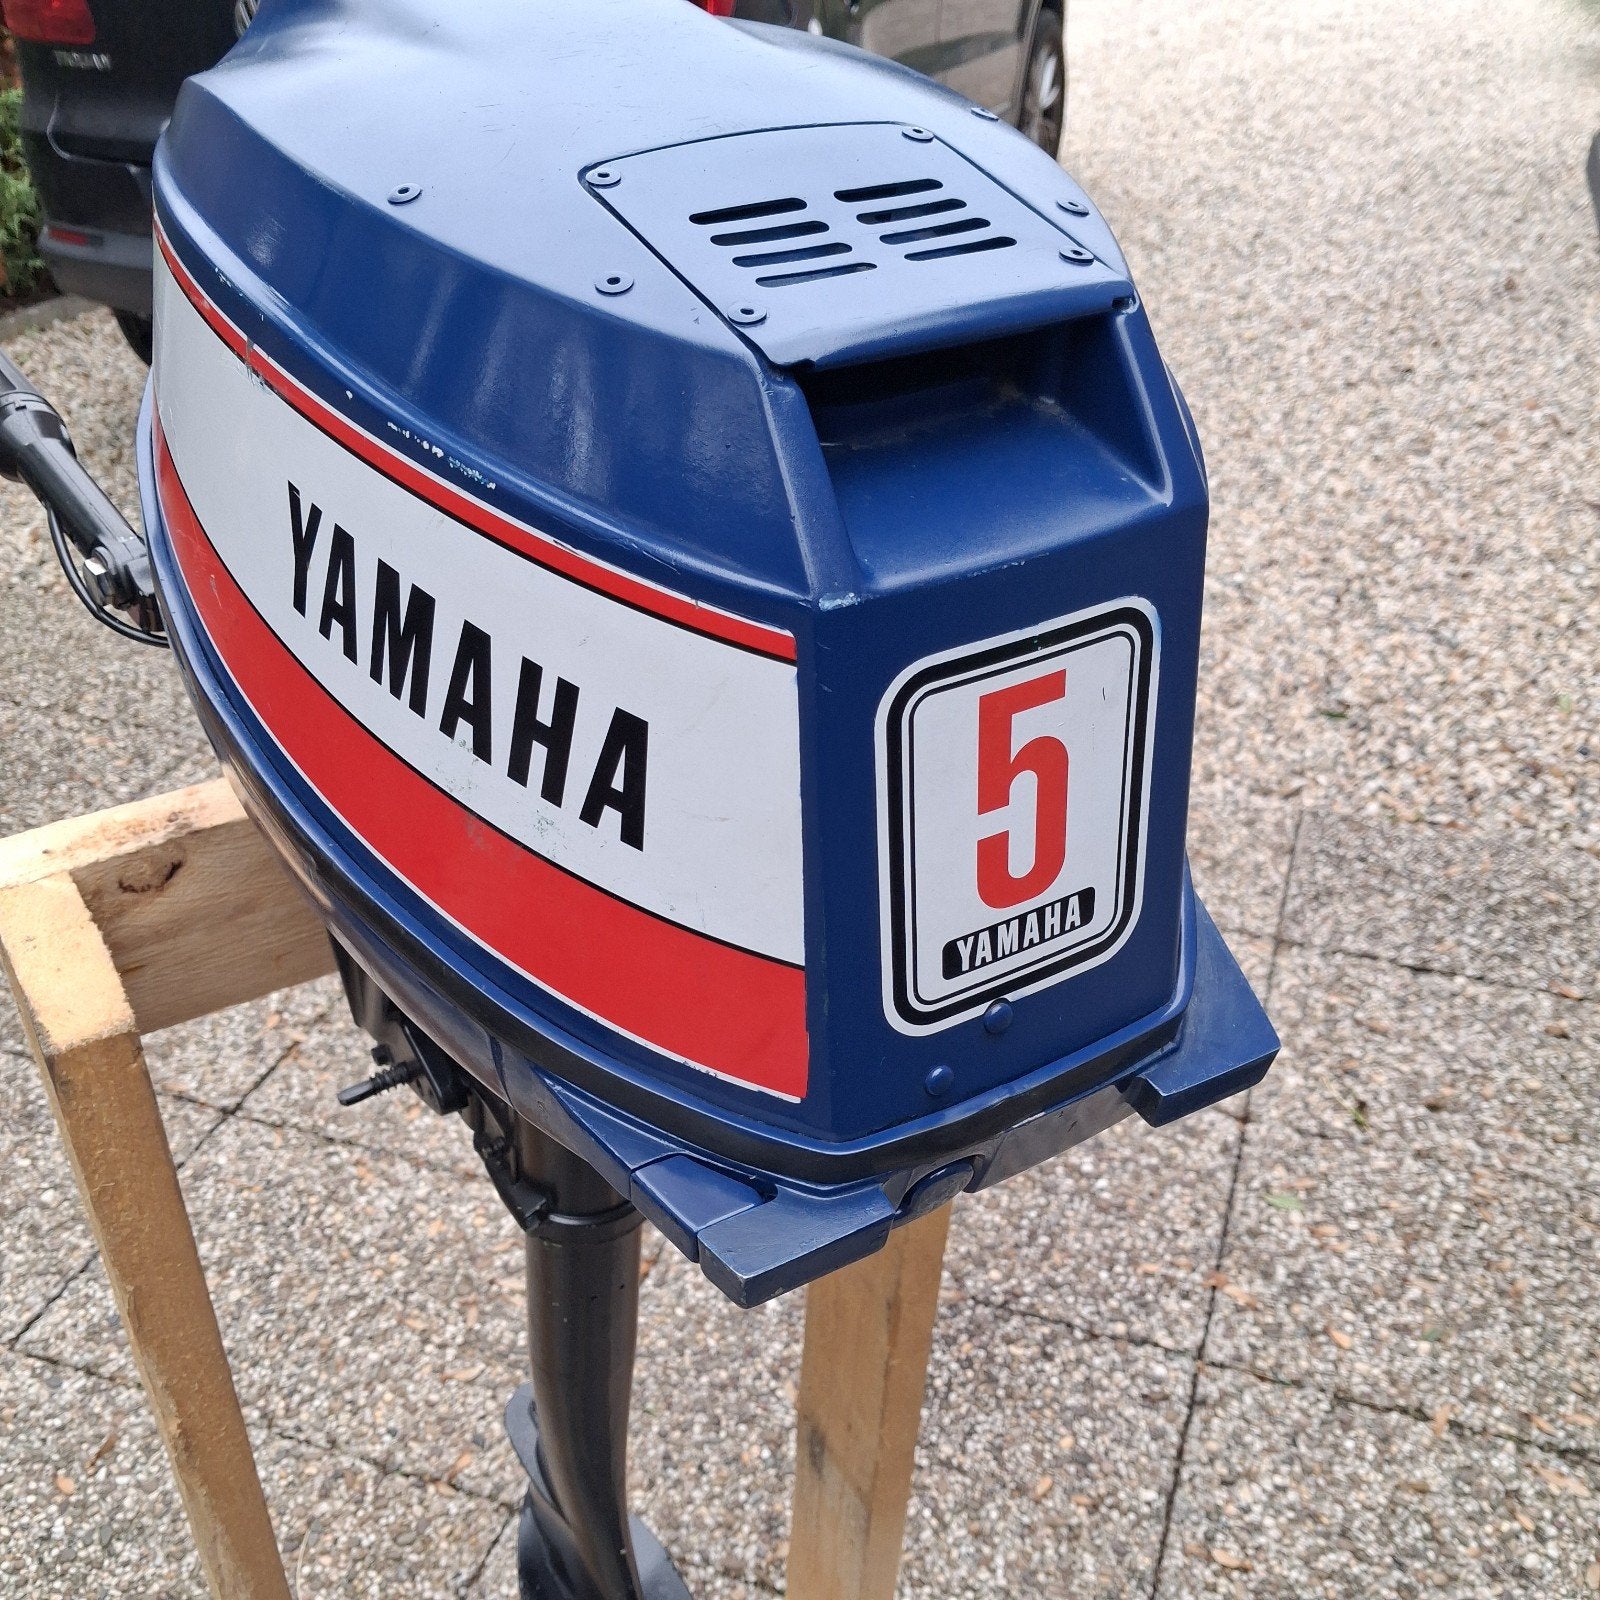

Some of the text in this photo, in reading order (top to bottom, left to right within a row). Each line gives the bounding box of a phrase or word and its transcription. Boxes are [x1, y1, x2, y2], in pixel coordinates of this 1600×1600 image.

[288, 480, 649, 852] YAMAHA
[976, 668, 1069, 909] 5
[956, 894, 1081, 971] YAMAHA
